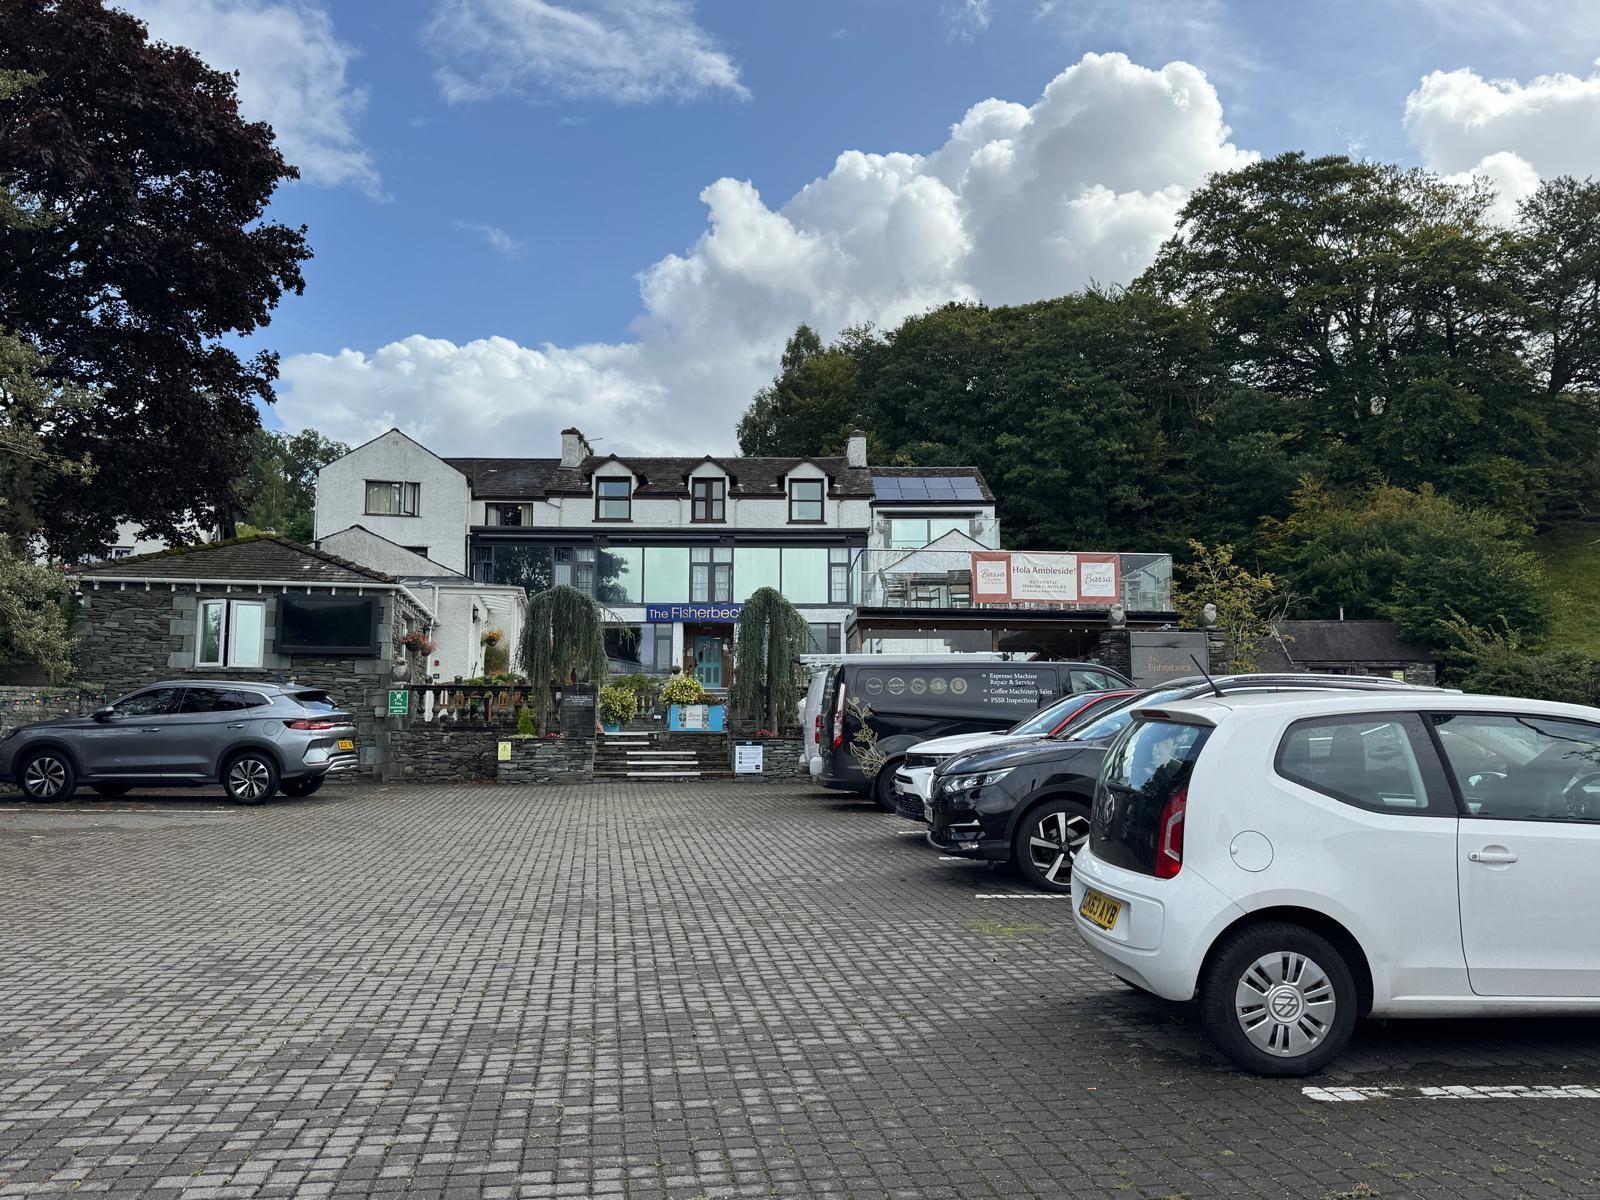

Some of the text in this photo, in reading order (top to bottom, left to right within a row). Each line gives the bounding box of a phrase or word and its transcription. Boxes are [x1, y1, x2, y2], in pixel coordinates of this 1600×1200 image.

[1012, 566, 1076, 575] Hola Ambleside!
[1084, 573, 1112, 585] Bassa
[649, 609, 669, 619] The
[1006, 697, 1037, 705] Inspections
[1098, 901, 1118, 925] AYB
